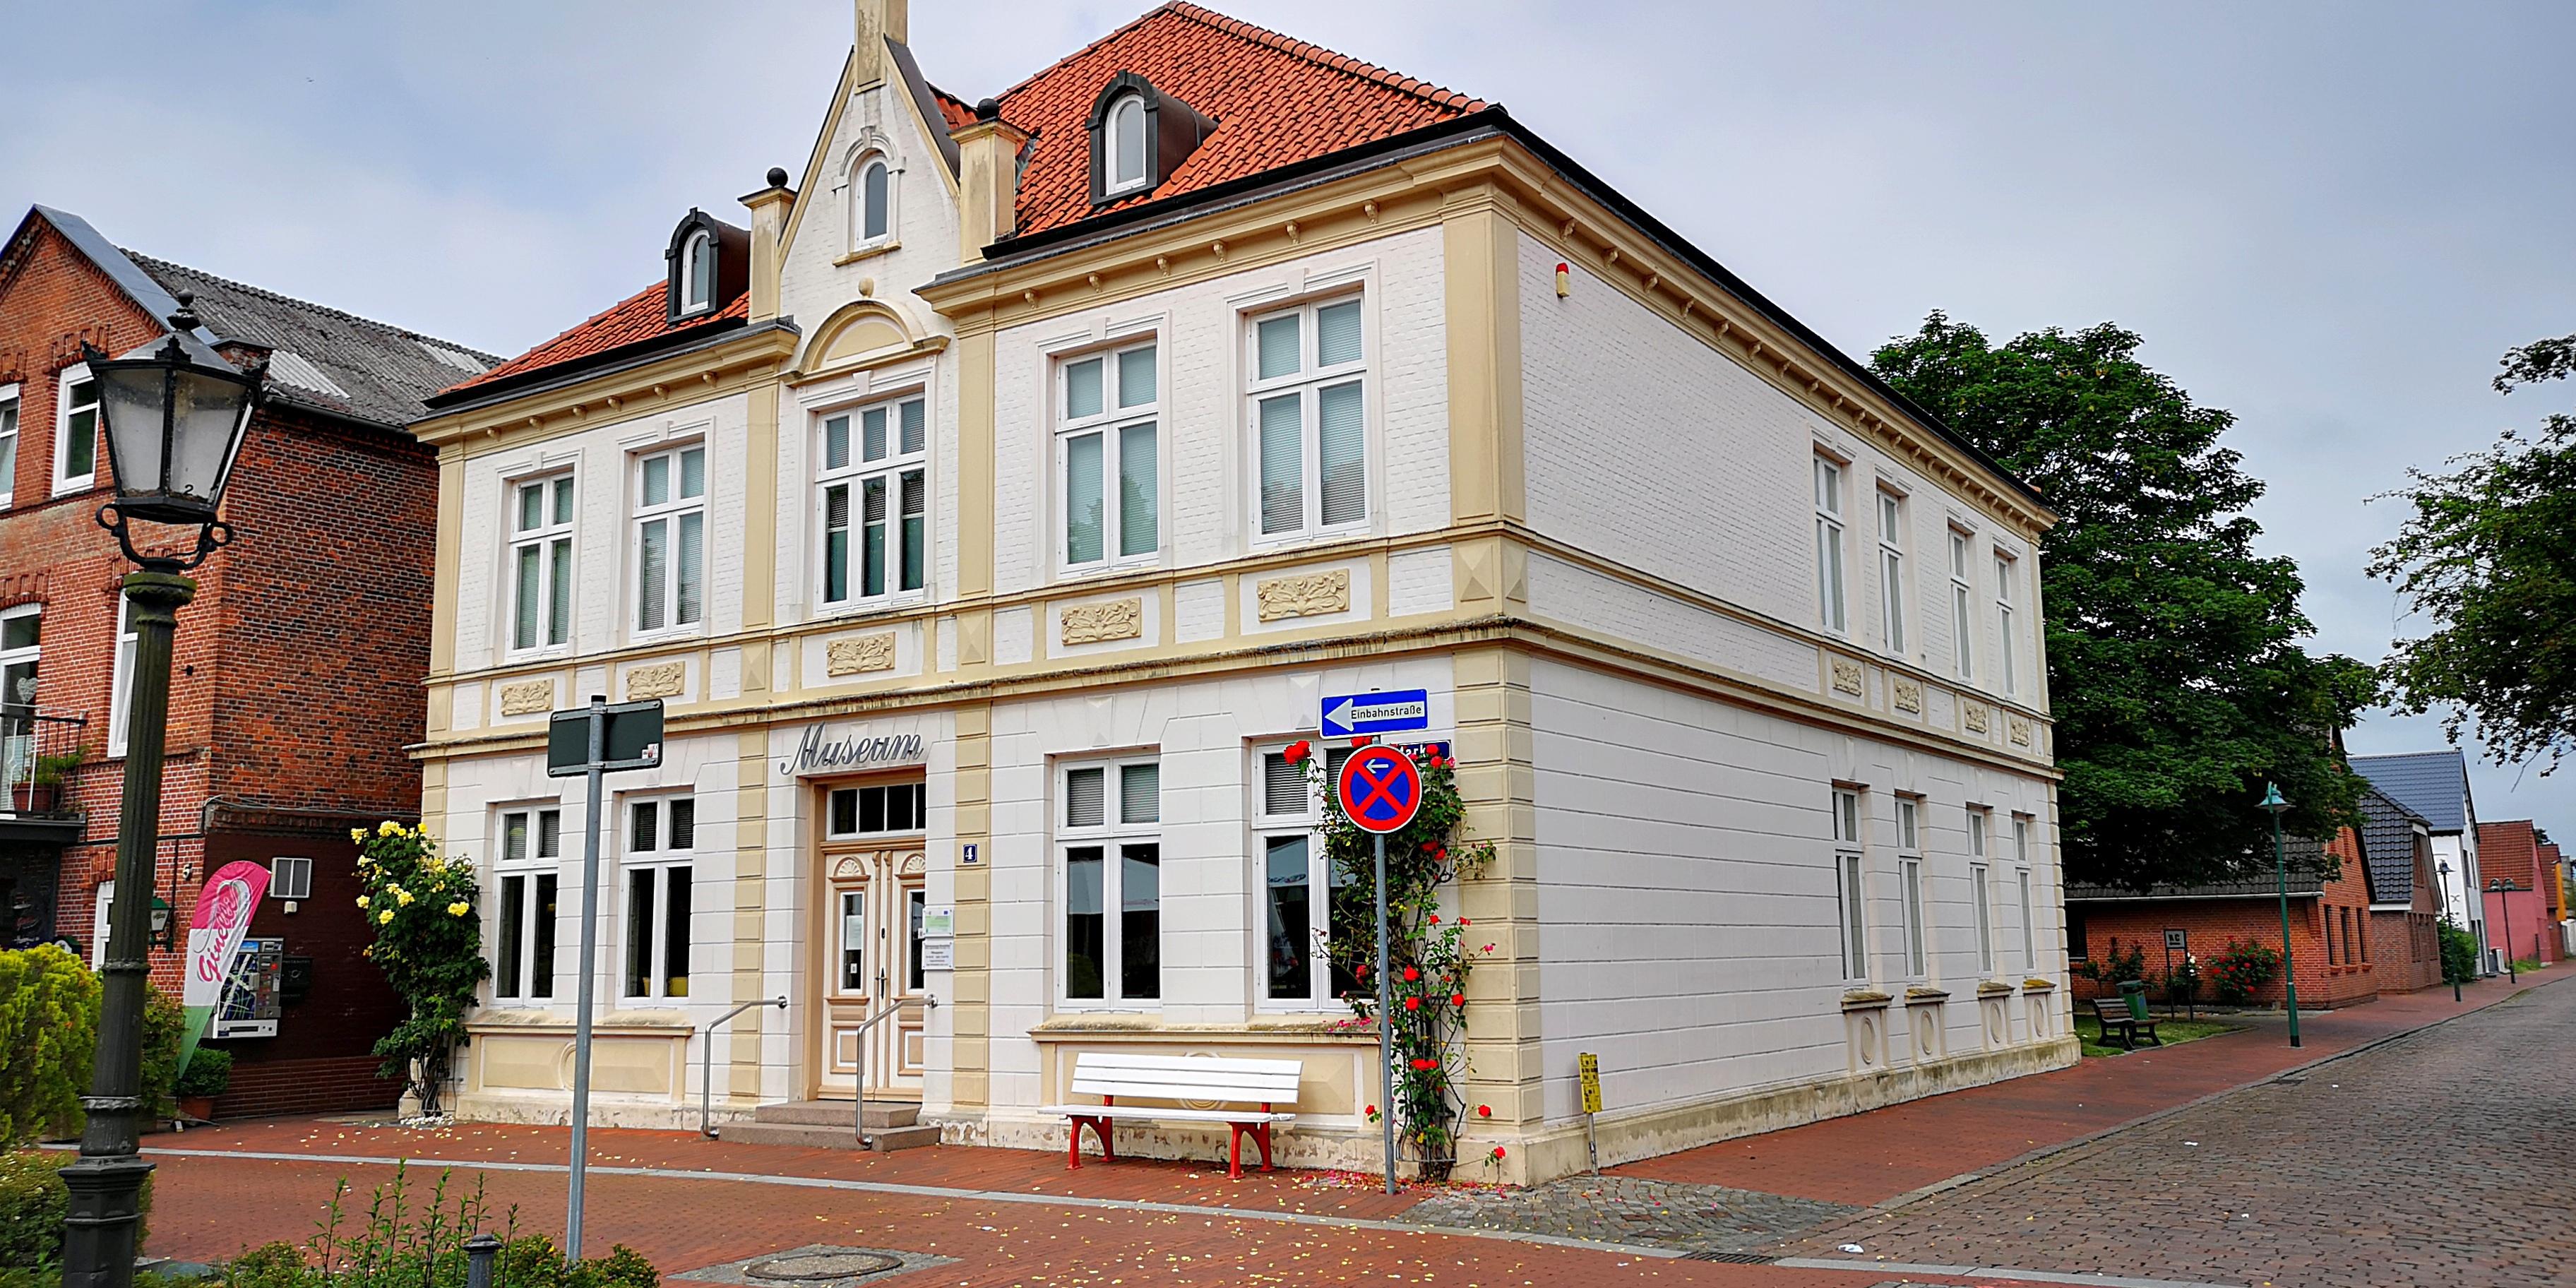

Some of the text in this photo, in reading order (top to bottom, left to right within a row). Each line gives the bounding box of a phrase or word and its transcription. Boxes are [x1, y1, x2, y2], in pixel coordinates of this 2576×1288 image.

[1351, 705, 1422, 720] Einbahnstraße
[780, 721, 924, 775] Museum
[965, 847, 974, 860] 4
[182, 863, 191, 879] 5
[198, 895, 239, 983] Ginelli
